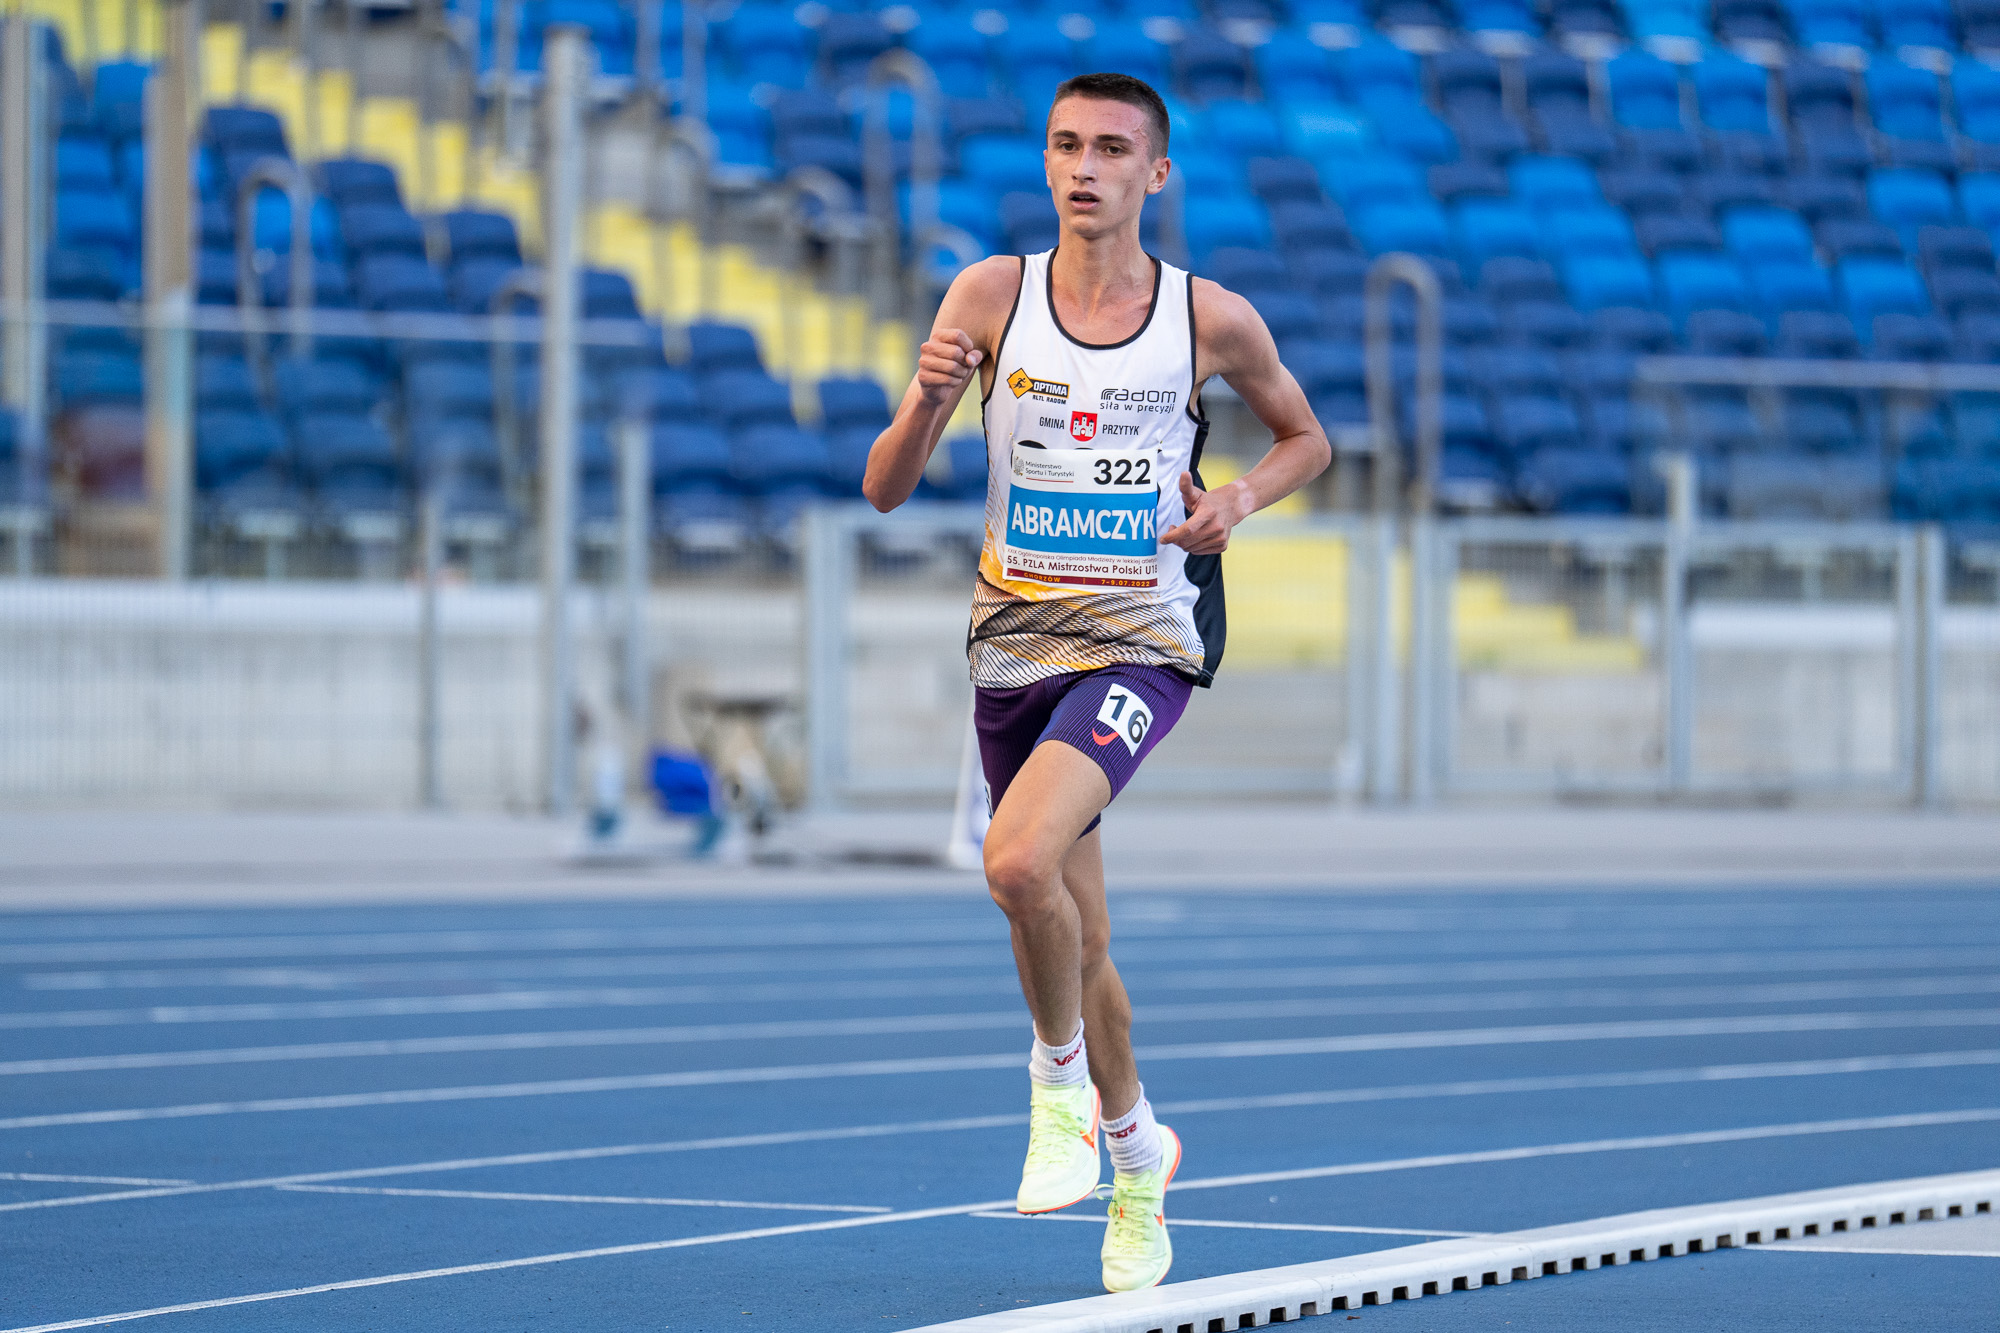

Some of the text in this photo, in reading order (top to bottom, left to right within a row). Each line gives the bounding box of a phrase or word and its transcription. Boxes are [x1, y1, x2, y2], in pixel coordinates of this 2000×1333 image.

[1033, 381, 1067, 396] OPTIMA
[1032, 394, 1067, 405] RLTL RADOM
[1100, 401, 1119, 410] siła
[1137, 403, 1175, 414] precyzji
[1039, 416, 1140, 436] GMINA PRZYTYK
[1025, 461, 1062, 469] Ministerstwo
[1093, 458, 1151, 485] 322
[1025, 467, 1044, 476] Sportu
[1048, 470, 1075, 478] Turystyki
[1011, 502, 1156, 541] ABRAMCZYK
[1018, 550, 1055, 560] Ogólnopolska
[1056, 554, 1087, 562] Olimpiada
[1087, 556, 1116, 564] Młodzieży
[1007, 555, 1021, 566] 55.
[1023, 558, 1045, 570] PZLA
[1048, 561, 1109, 573] Mistrzostwa
[1112, 564, 1142, 575] Polski
[1023, 572, 1061, 583] CHORZÓW
[1109, 694, 1148, 745] 16
